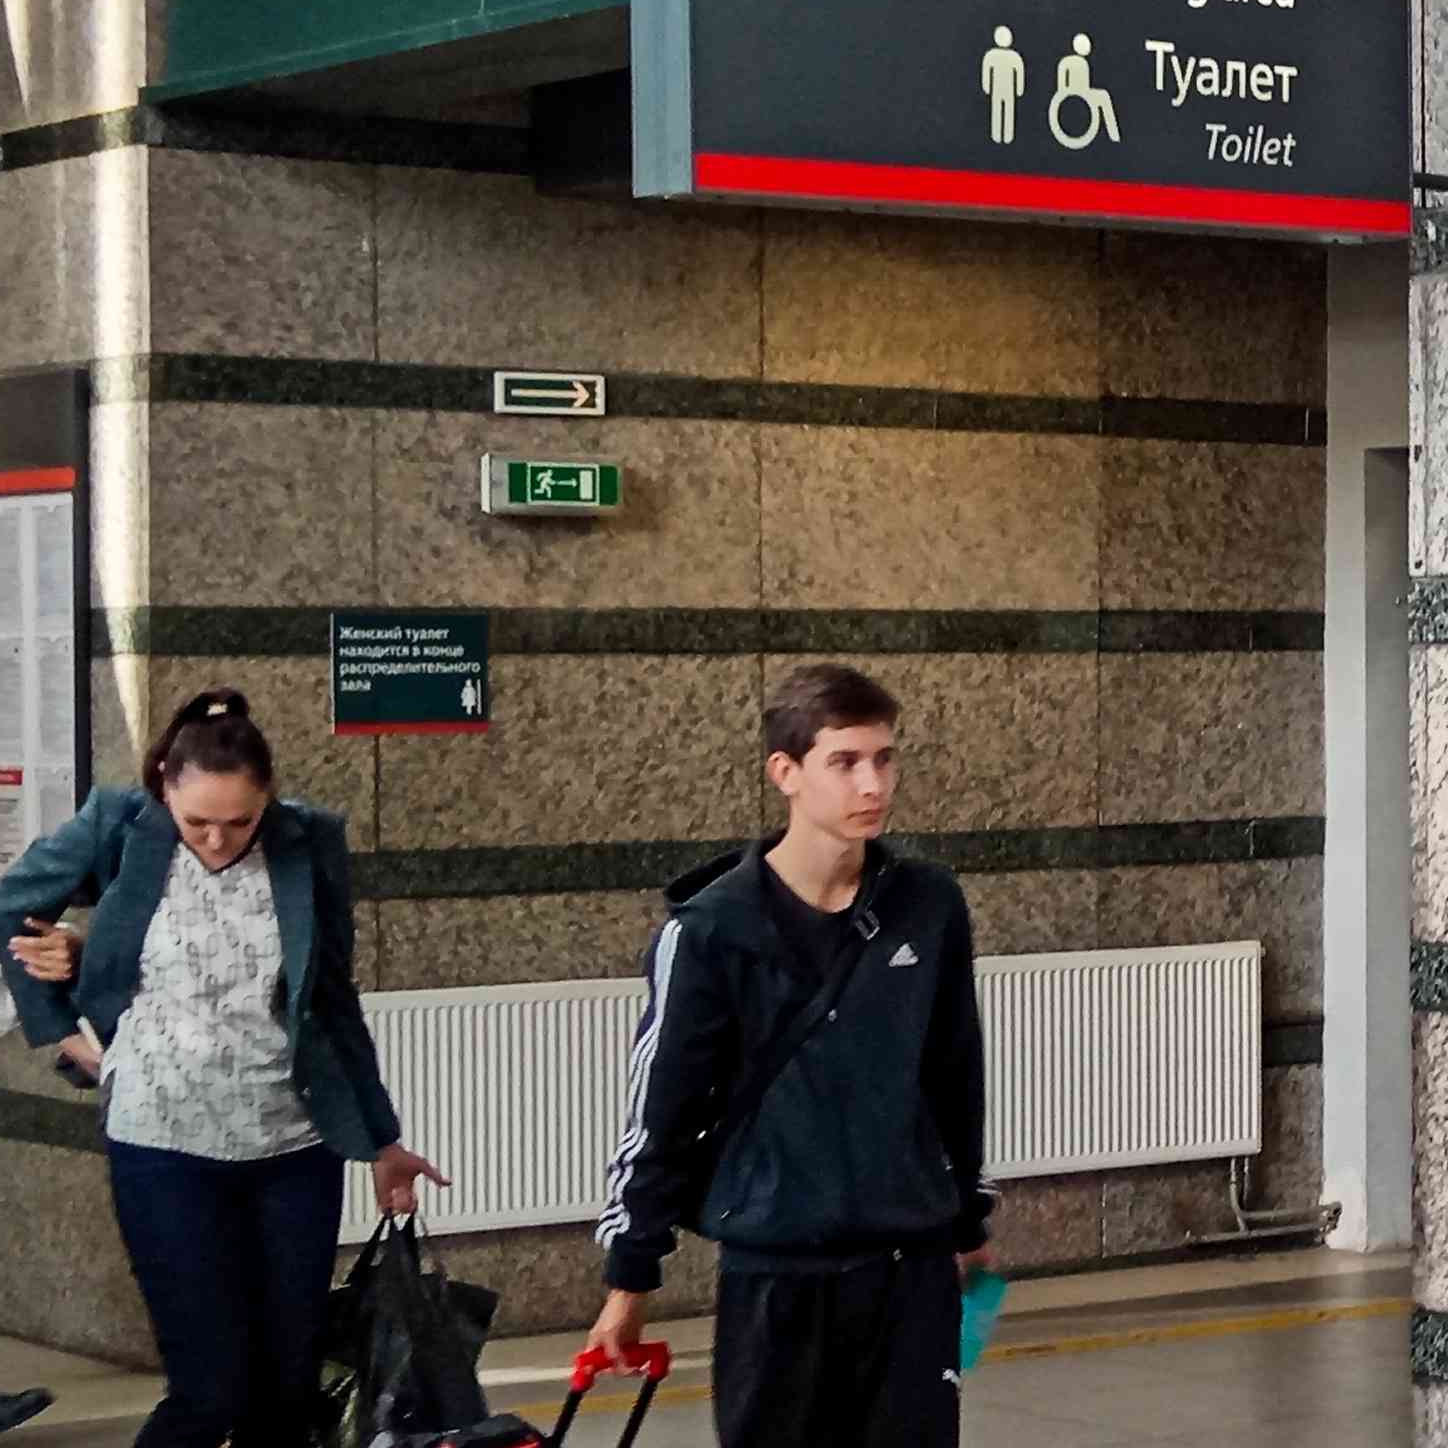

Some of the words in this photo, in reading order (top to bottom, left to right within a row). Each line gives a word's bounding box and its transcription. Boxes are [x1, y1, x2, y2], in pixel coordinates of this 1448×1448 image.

[1145, 40, 1298, 107] Туалет
[1205, 124, 1296, 167] Toilet
[339, 626, 403, 640] Женский
[405, 628, 450, 642] туалет
[339, 646, 409, 658] находится
[423, 646, 465, 658] конце
[339, 662, 481, 676] распределительного
